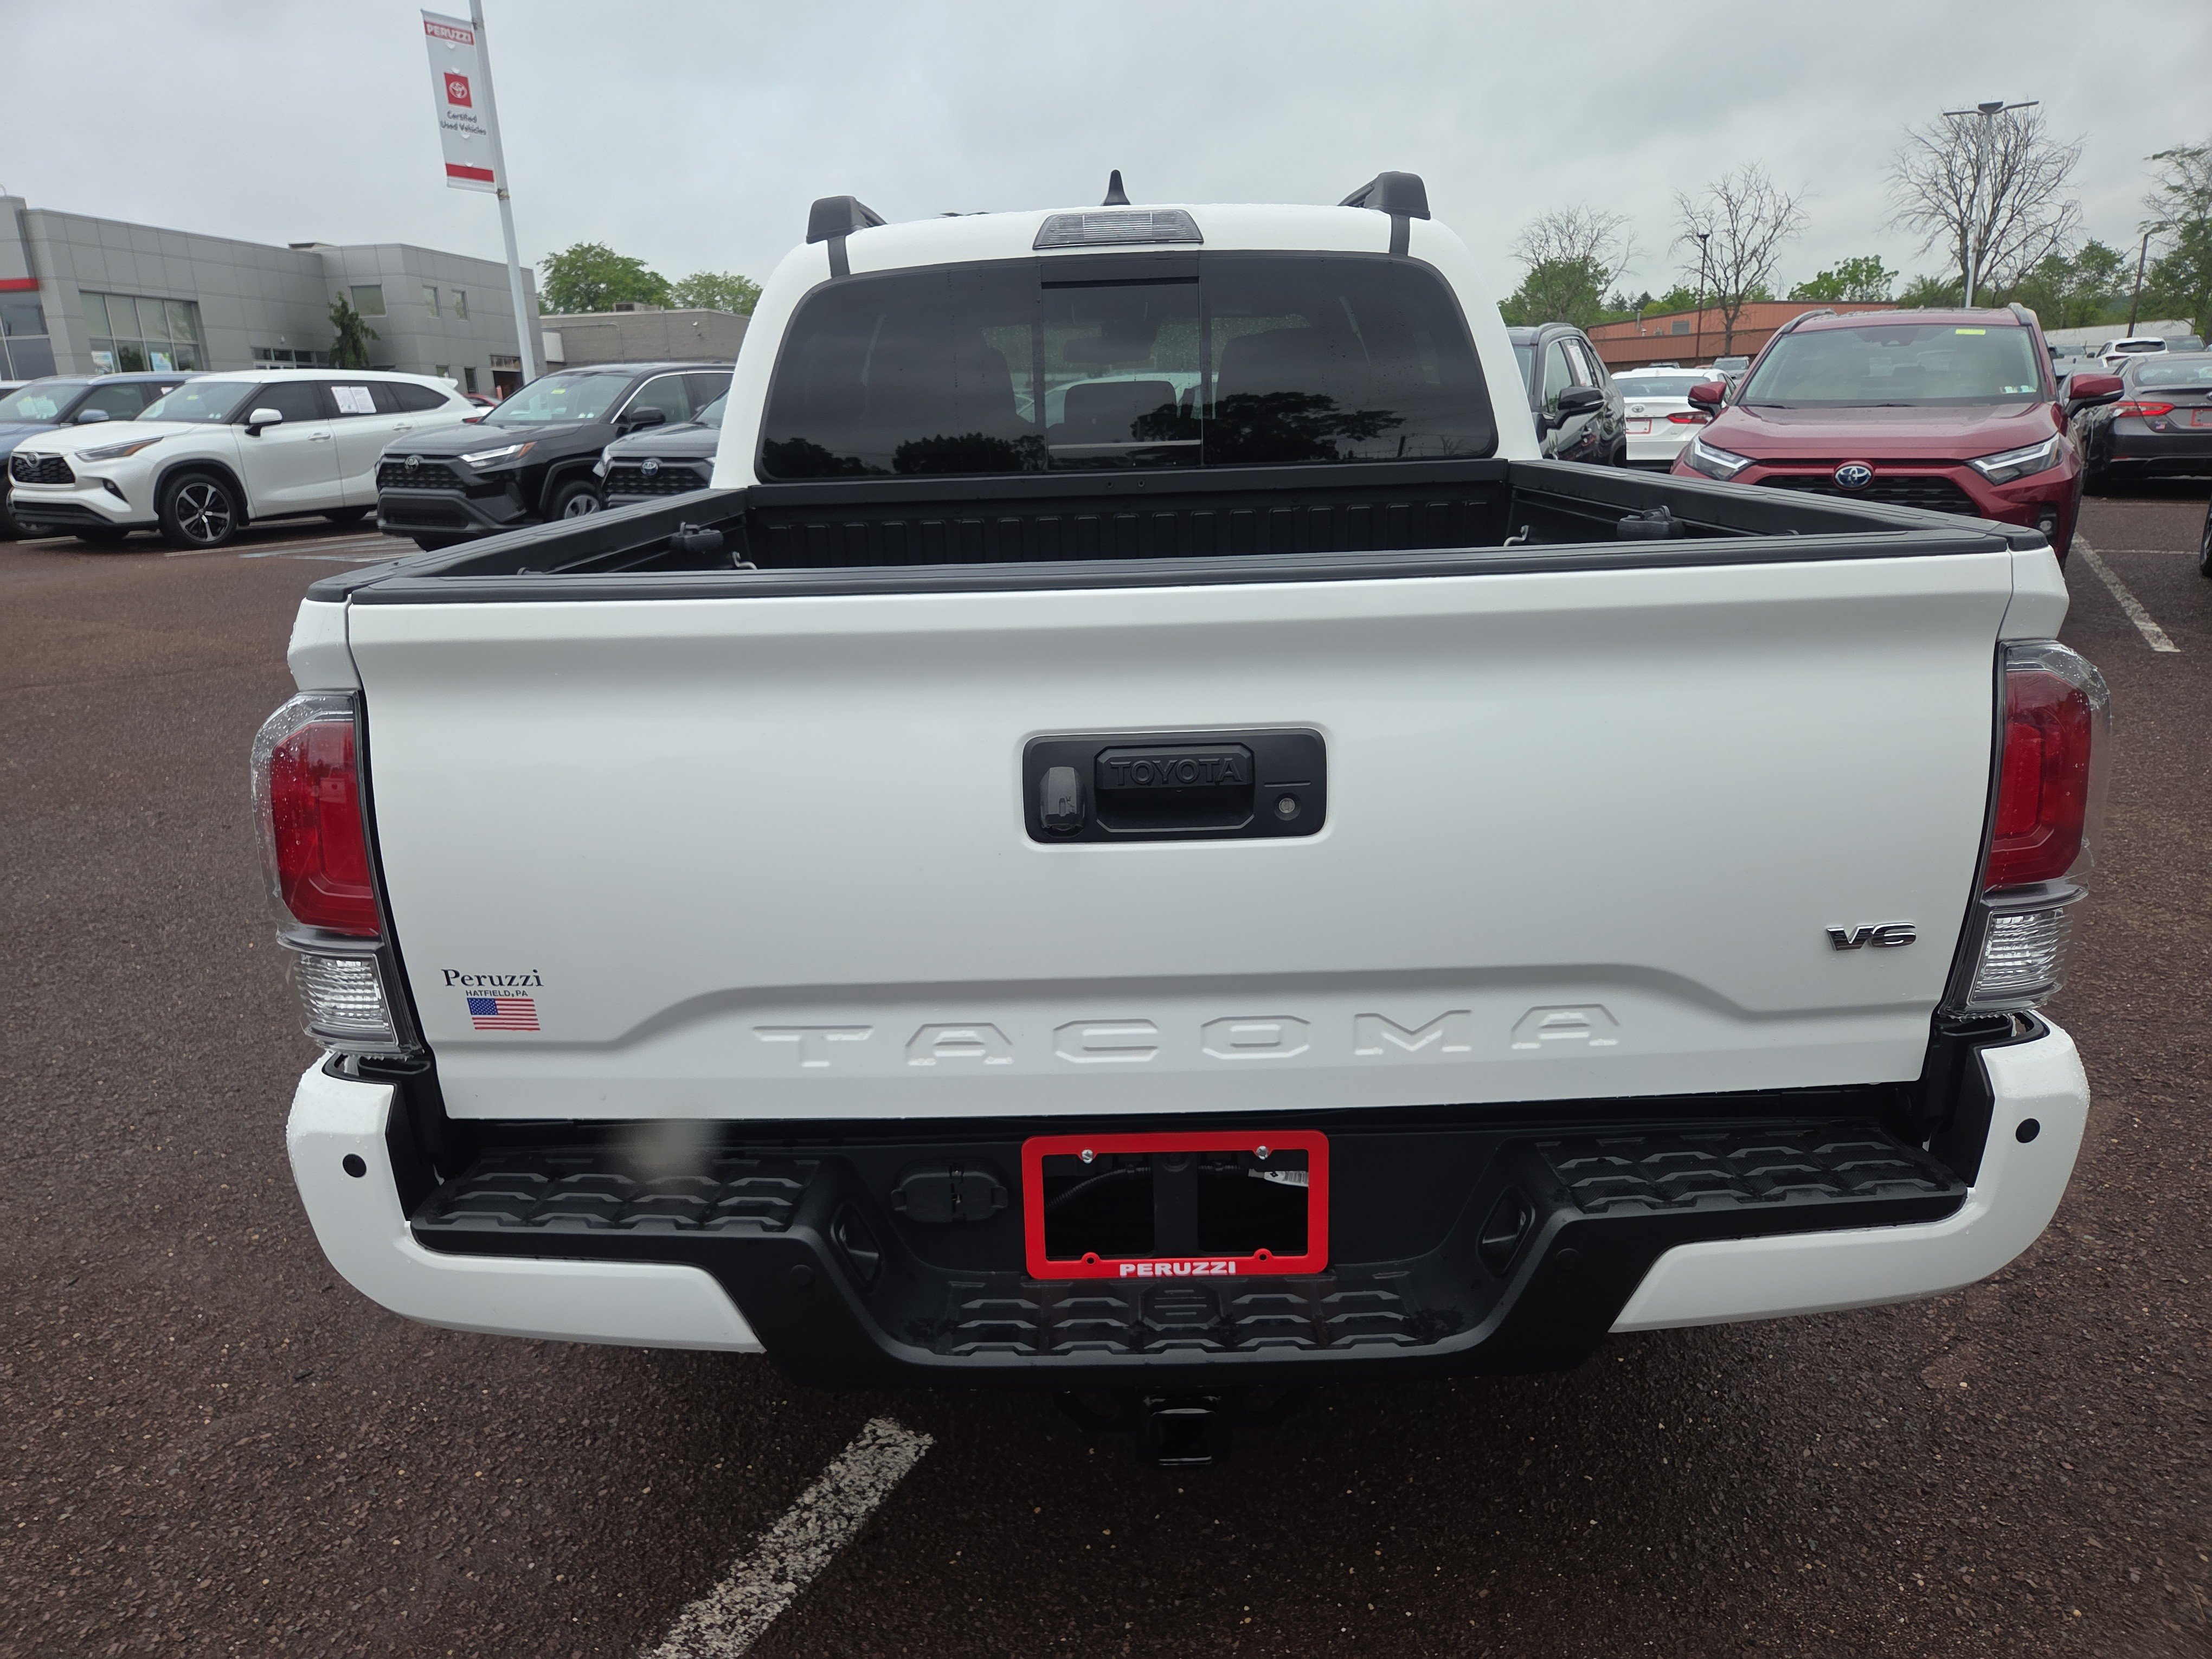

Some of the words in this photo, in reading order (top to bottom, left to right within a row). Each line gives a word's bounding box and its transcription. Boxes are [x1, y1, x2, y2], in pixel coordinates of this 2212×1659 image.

[426, 24, 472, 42] PERUZZI
[459, 122, 486, 136] Vehicles
[1110, 758, 1244, 786] TOYOTA
[1826, 922, 1917, 951] V6
[441, 968, 544, 987] Peruzzi
[751, 1003, 1620, 1068] TACOMA
[1119, 1261, 1237, 1277] PERUZZI
